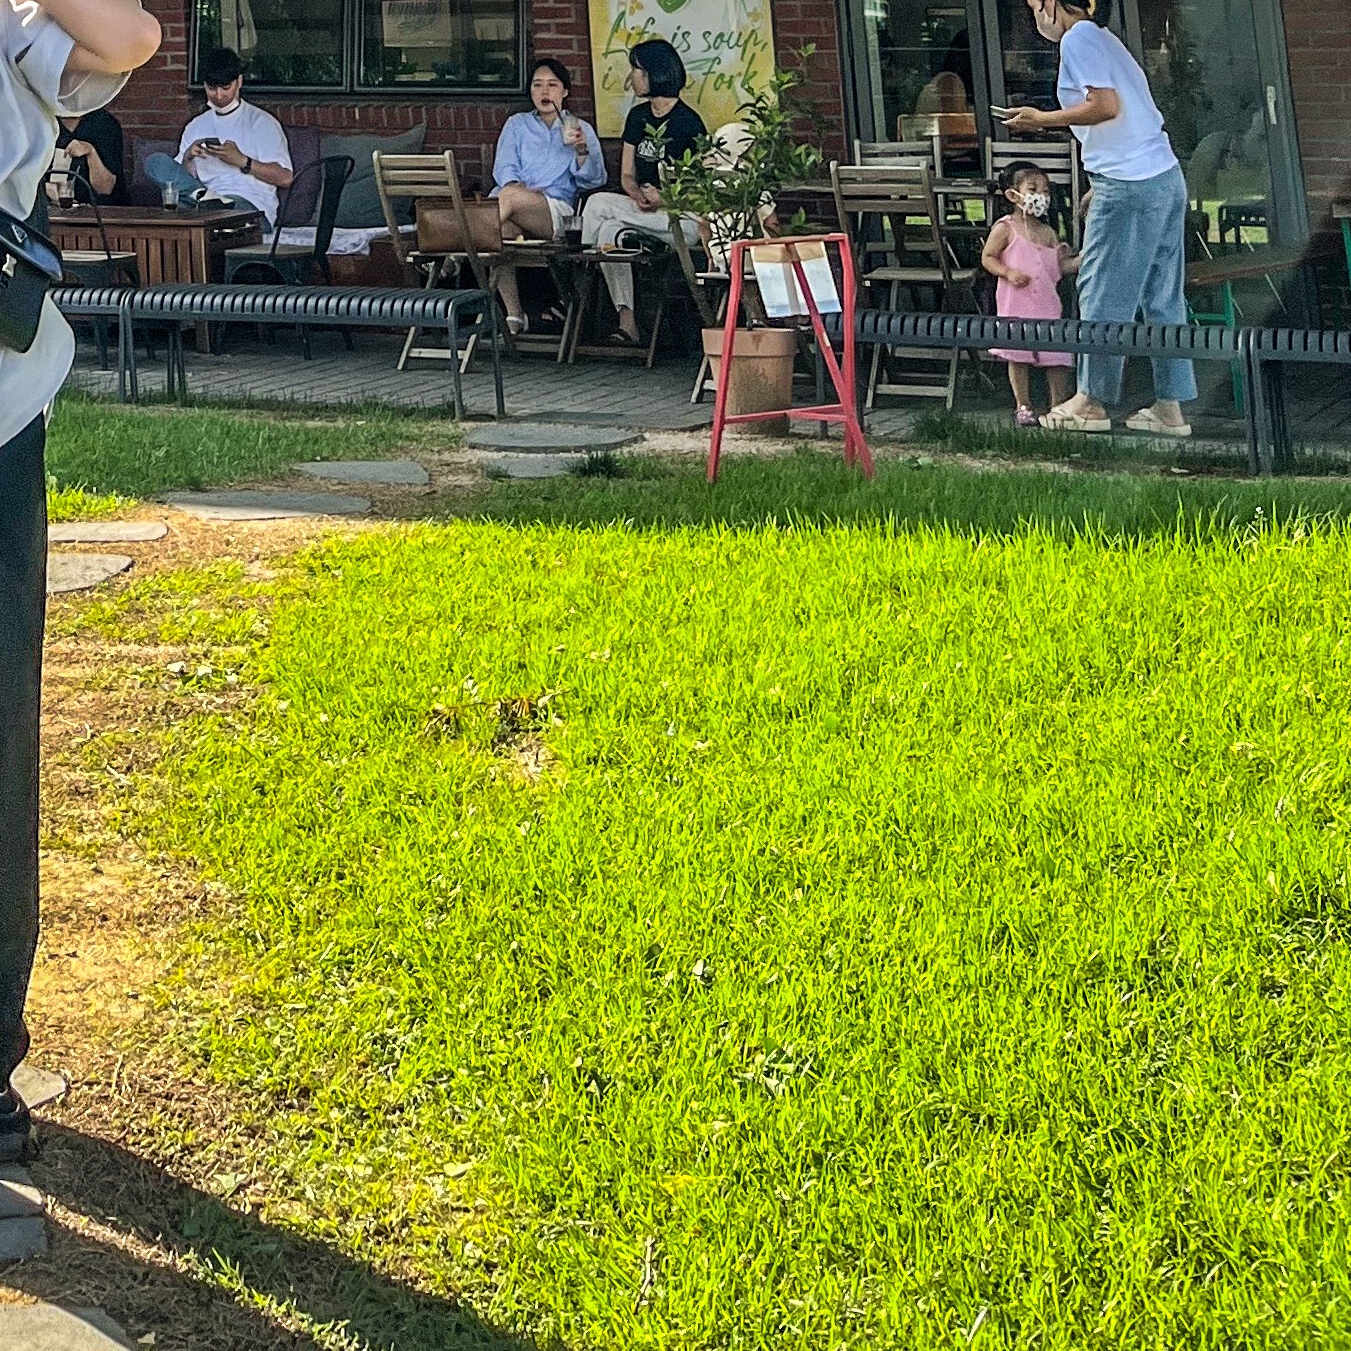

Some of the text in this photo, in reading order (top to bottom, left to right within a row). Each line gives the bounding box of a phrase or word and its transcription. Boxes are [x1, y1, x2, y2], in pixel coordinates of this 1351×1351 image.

[602, 10, 768, 60] Lif is soup,
[699, 53, 758, 105] fork
